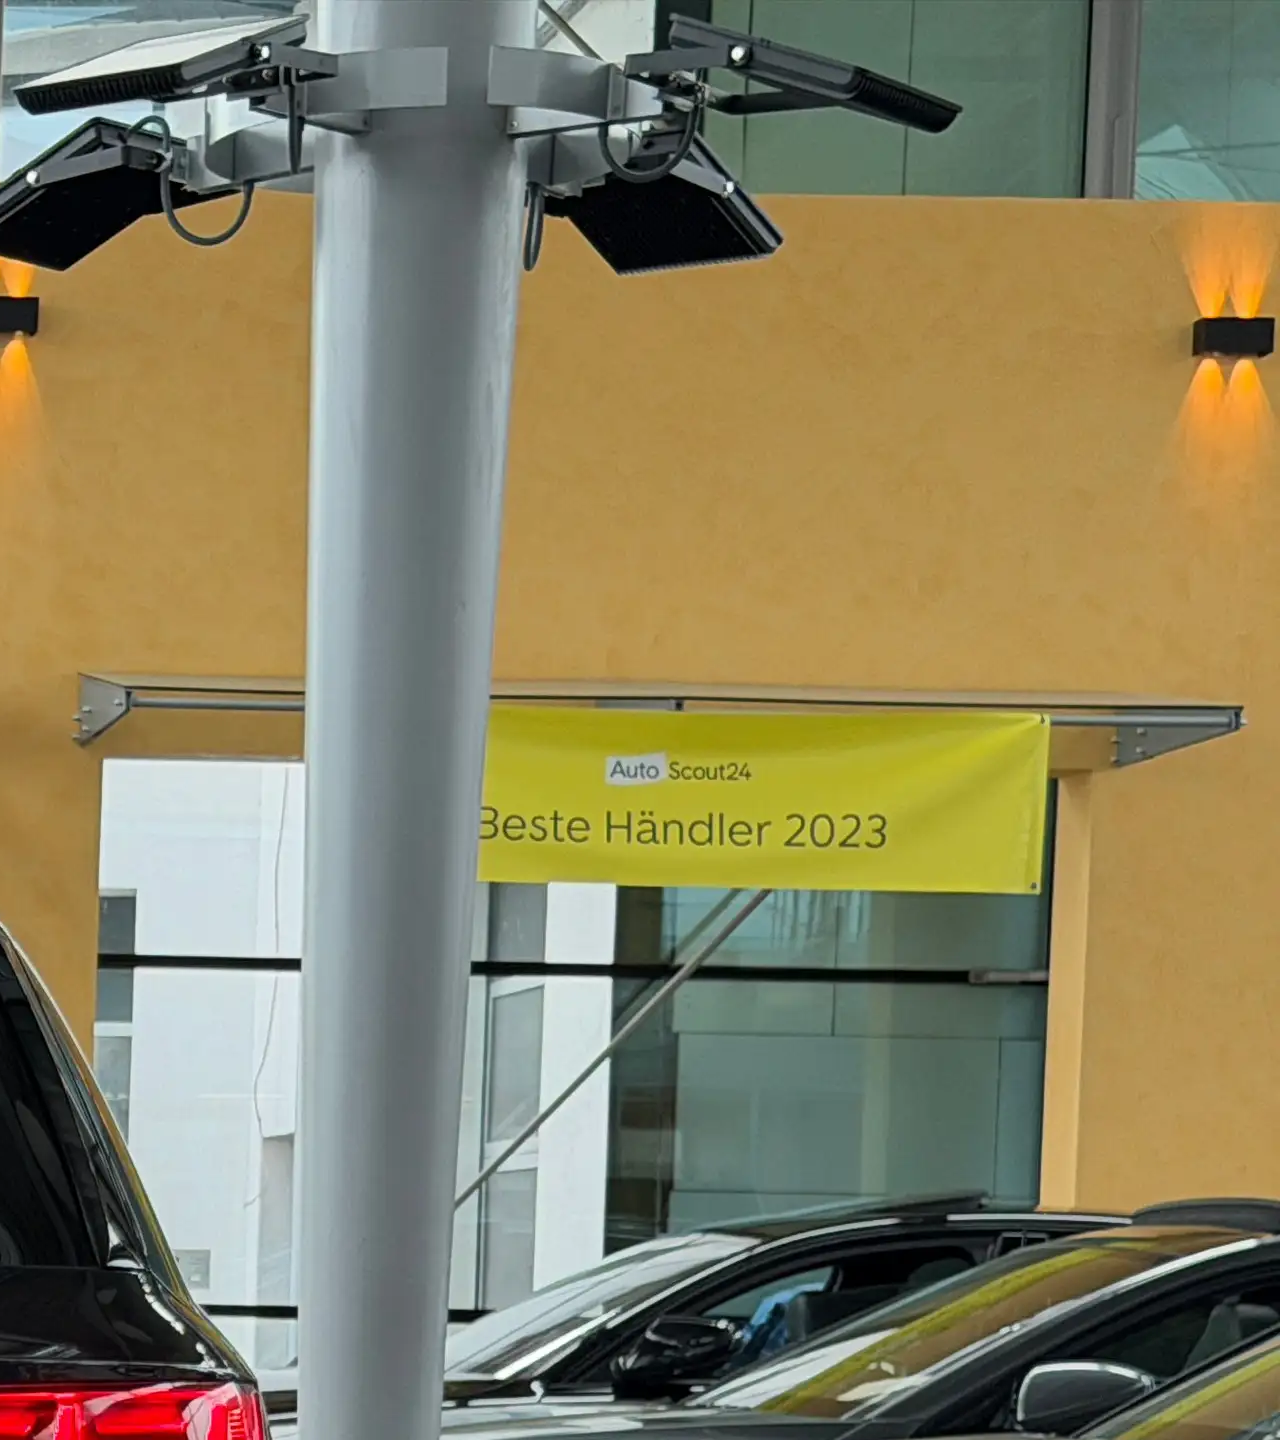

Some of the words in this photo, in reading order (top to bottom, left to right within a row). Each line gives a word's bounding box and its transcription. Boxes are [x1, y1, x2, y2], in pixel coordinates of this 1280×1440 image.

[610, 760, 660, 781] Auto
[668, 761, 752, 782] Scout24
[479, 806, 591, 844] Beste
[605, 810, 772, 848] Händler
[785, 814, 887, 849] 2023
